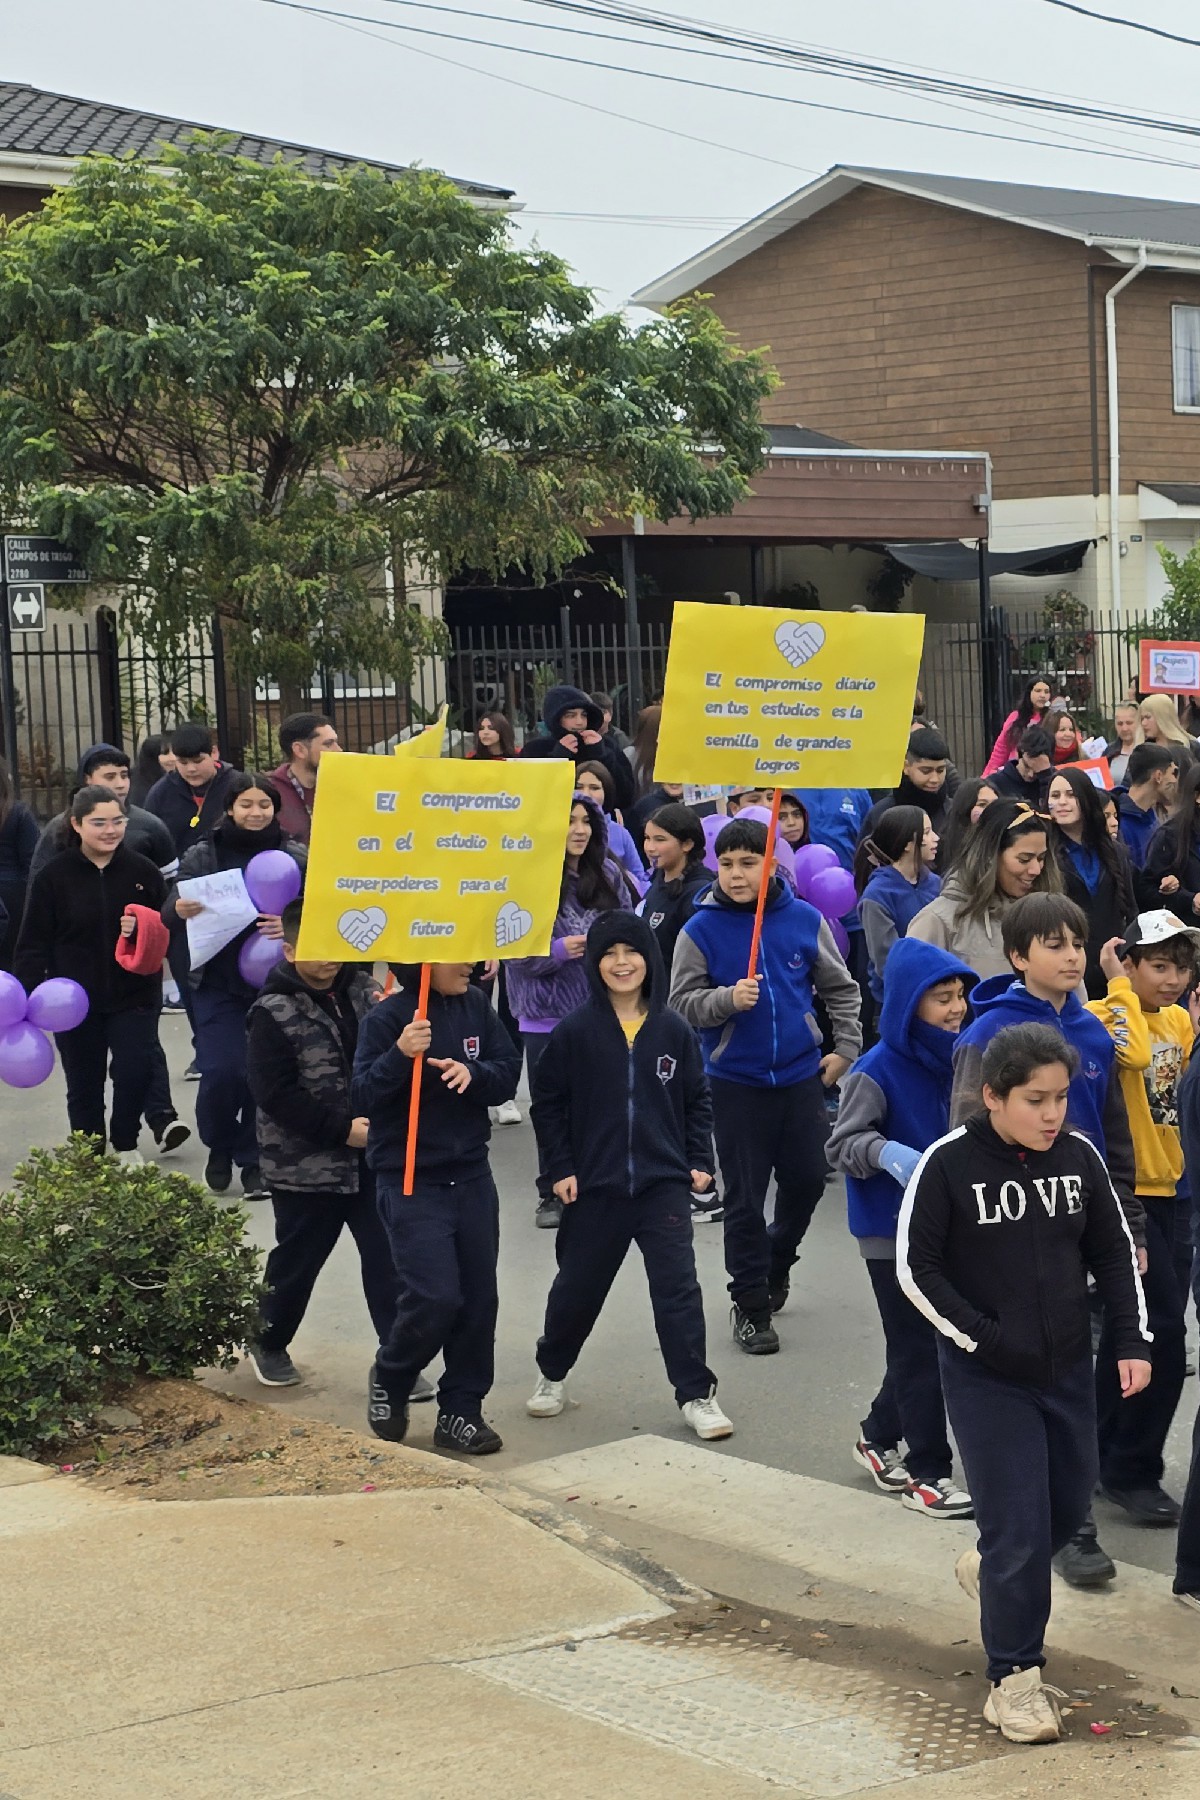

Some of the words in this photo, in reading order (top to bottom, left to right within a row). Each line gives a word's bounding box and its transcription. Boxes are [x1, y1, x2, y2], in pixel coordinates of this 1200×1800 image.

[9, 540, 30, 550] CALLE
[9, 551, 38, 561] CAMPOS
[40, 551, 49, 561] DE
[705, 673, 722, 687] El
[735, 677, 822, 692] compromiso
[835, 677, 875, 691] diario
[705, 703, 723, 714] en
[727, 701, 748, 715] tus
[761, 703, 820, 717] estudios
[832, 707, 847, 718] es
[849, 706, 863, 718] la
[705, 734, 759, 748] semilla
[775, 734, 792, 747] de
[796, 737, 851, 751] grandes
[755, 758, 800, 773] logros
[377, 793, 398, 811] El
[421, 792, 521, 811] compromiso
[358, 836, 380, 850] en
[396, 832, 413, 850] el
[436, 834, 487, 849] estudio
[501, 836, 515, 849] te
[517, 836, 532, 850] da
[460, 878, 491, 895] para
[494, 876, 507, 891] el
